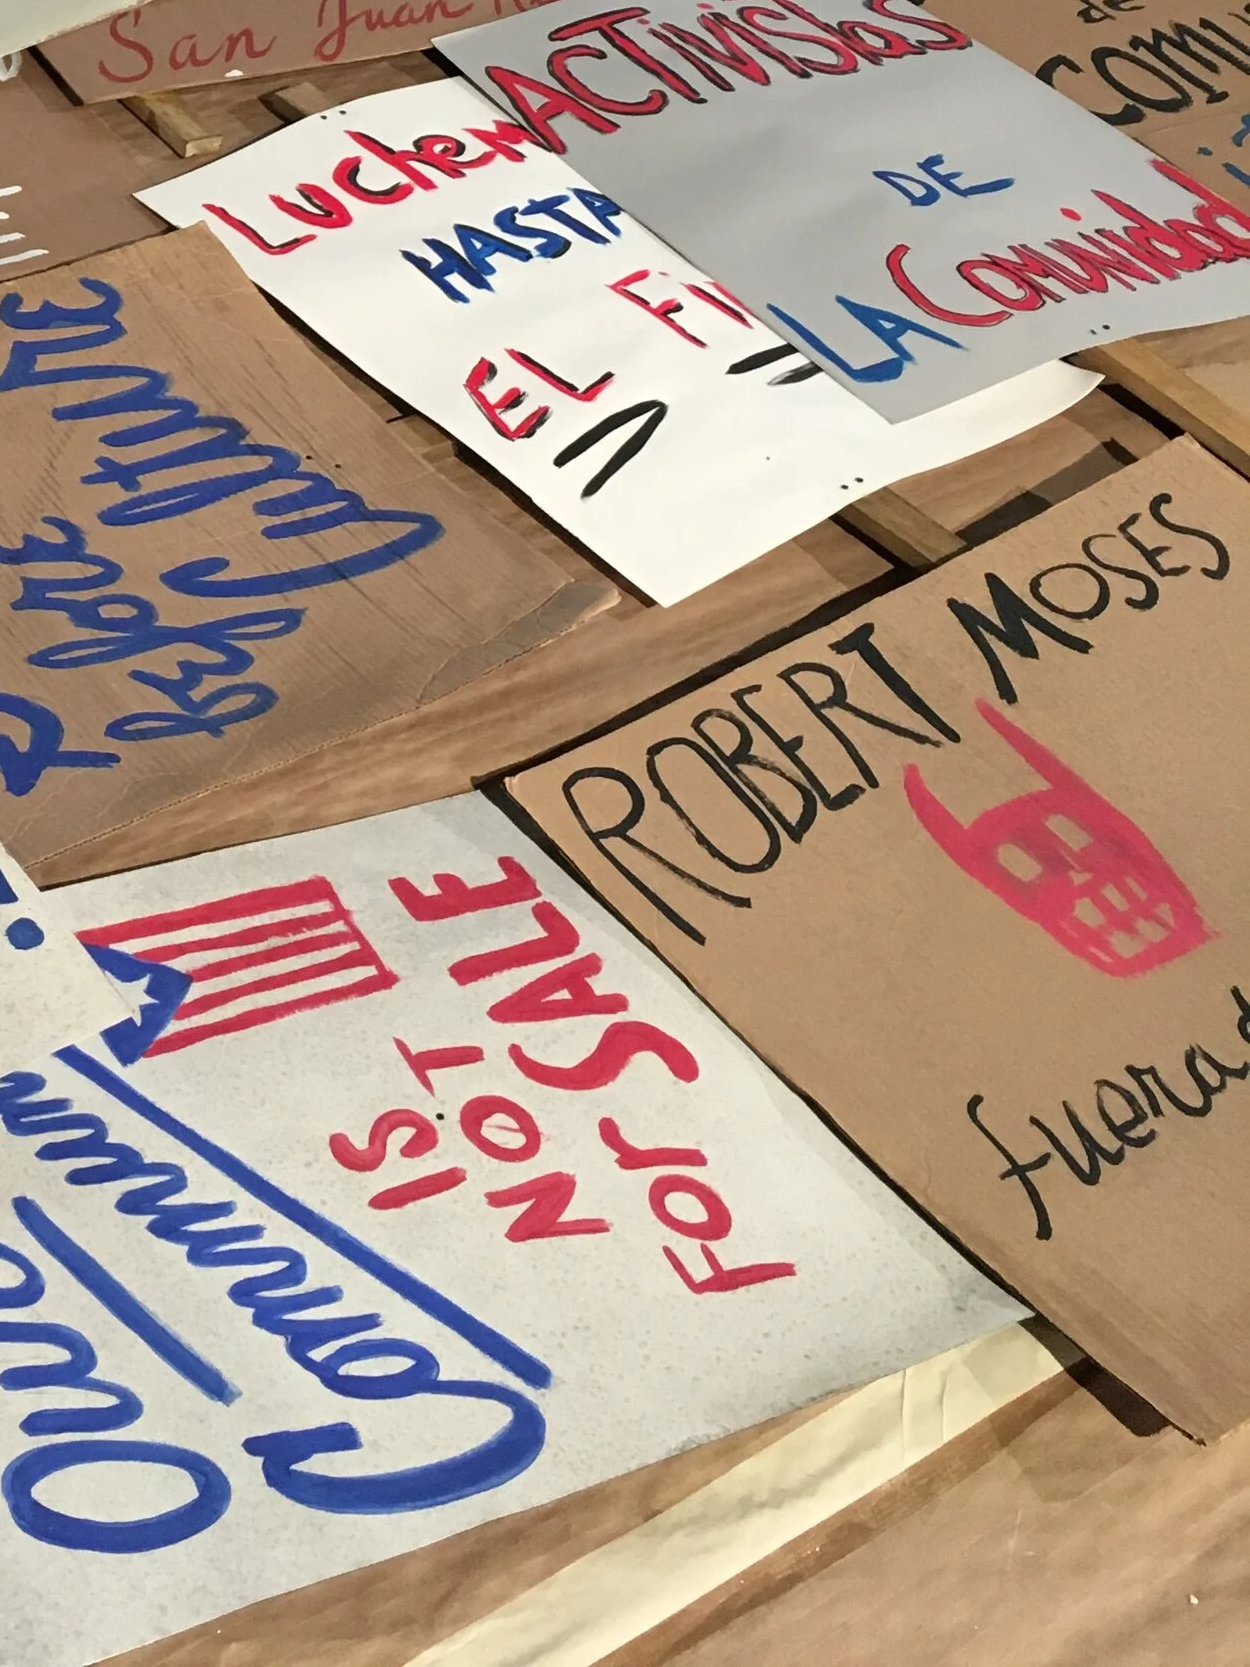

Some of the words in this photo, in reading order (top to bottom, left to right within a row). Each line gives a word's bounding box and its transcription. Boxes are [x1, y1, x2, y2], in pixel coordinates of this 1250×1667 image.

[98, 5, 278, 84] San
[869, 153, 1018, 210] DE
[764, 293, 963, 385] LA
[462, 345, 616, 441] EL
[562, 621, 962, 946] ROBERT
[946, 492, 1231, 705] MOSES
[387, 856, 701, 1092] SALE
[394, 1034, 614, 1244] NOT
